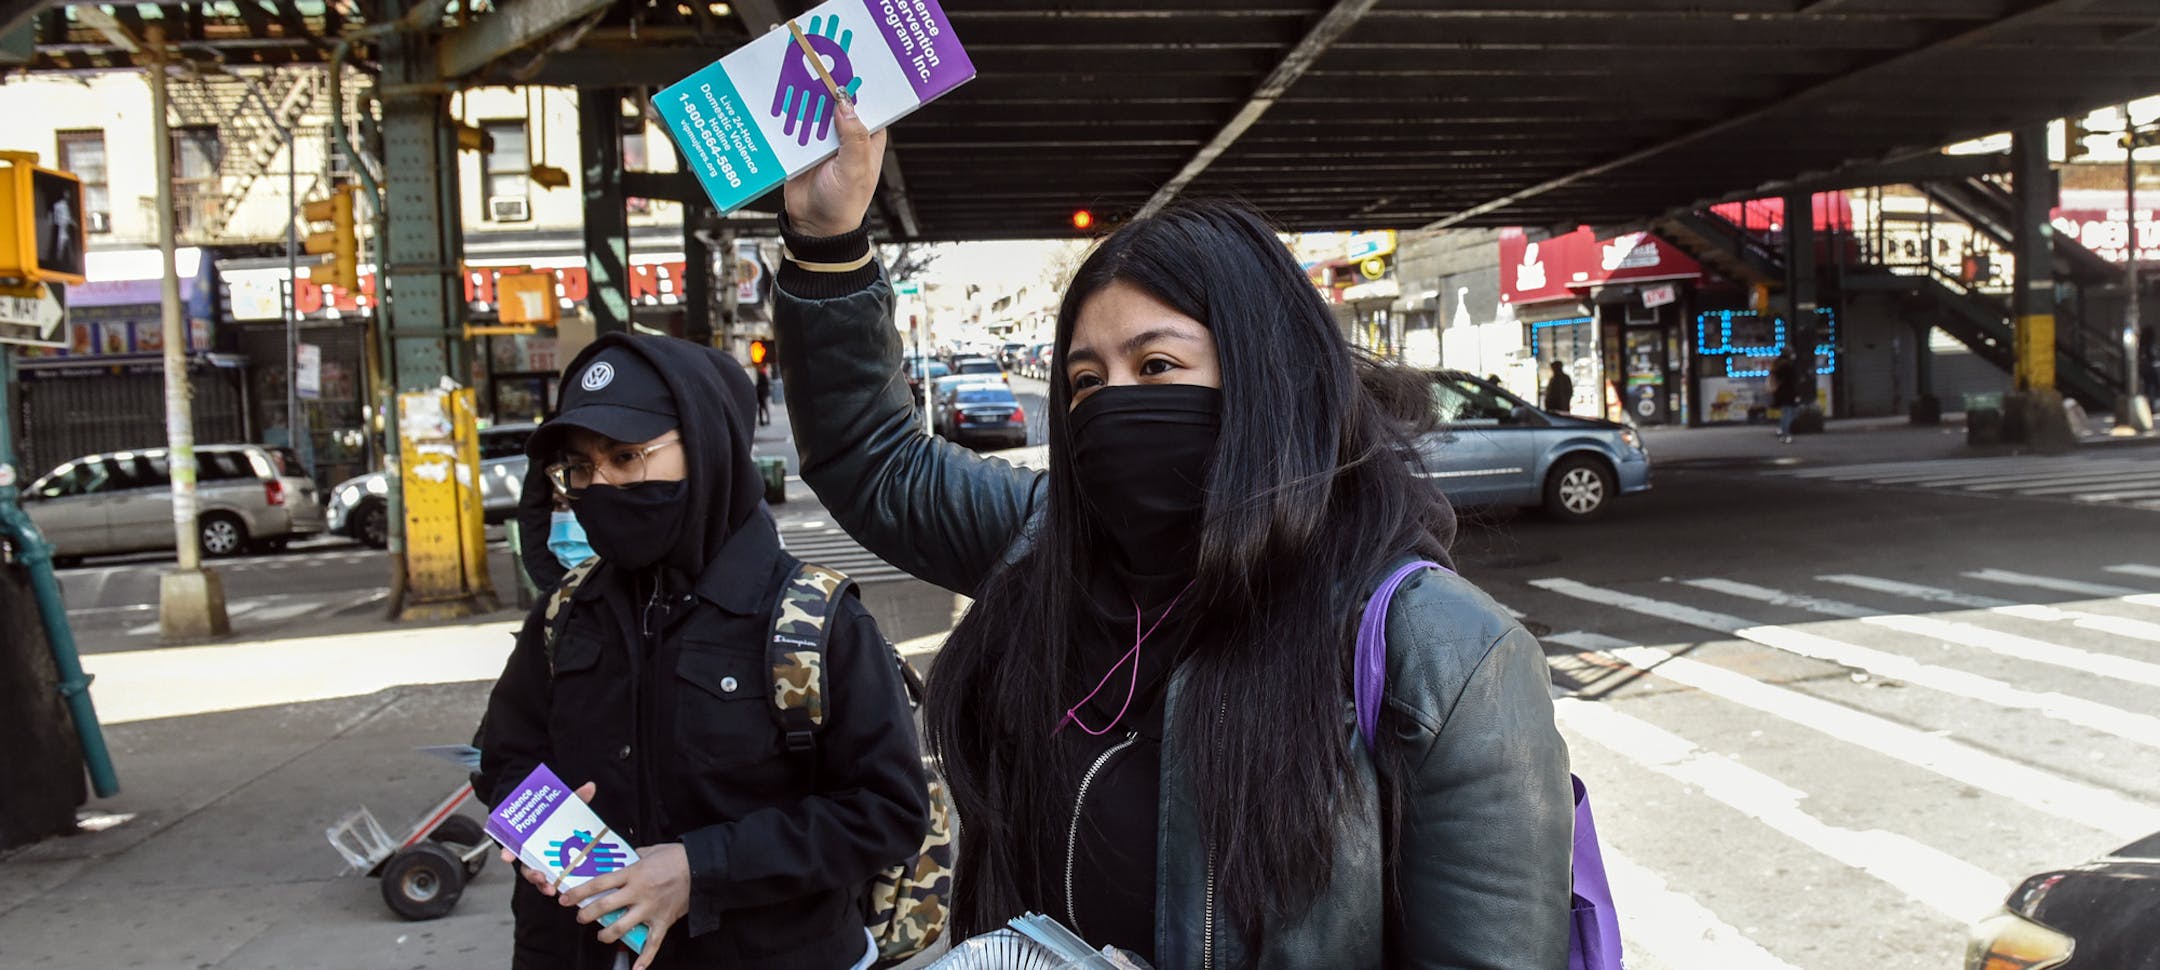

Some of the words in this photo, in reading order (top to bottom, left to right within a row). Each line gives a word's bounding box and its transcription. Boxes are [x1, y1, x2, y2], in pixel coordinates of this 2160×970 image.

[912, 54, 931, 84] Inc.
[679, 92, 742, 188] 1-800-664-5880
[700, 83, 732, 131] Domestic
[730, 130, 758, 174] Violence
[708, 117, 731, 151] Hotline
[719, 94, 735, 116] Live
[732, 115, 758, 152] 24-Hour
[680, 119, 718, 178] vipmujeres.org
[773, 634, 817, 647] Champion
[499, 788, 533, 819] Violence
[507, 785, 551, 827] Intervention
[515, 802, 550, 834] Program,
[545, 789, 562, 803] Inc.
